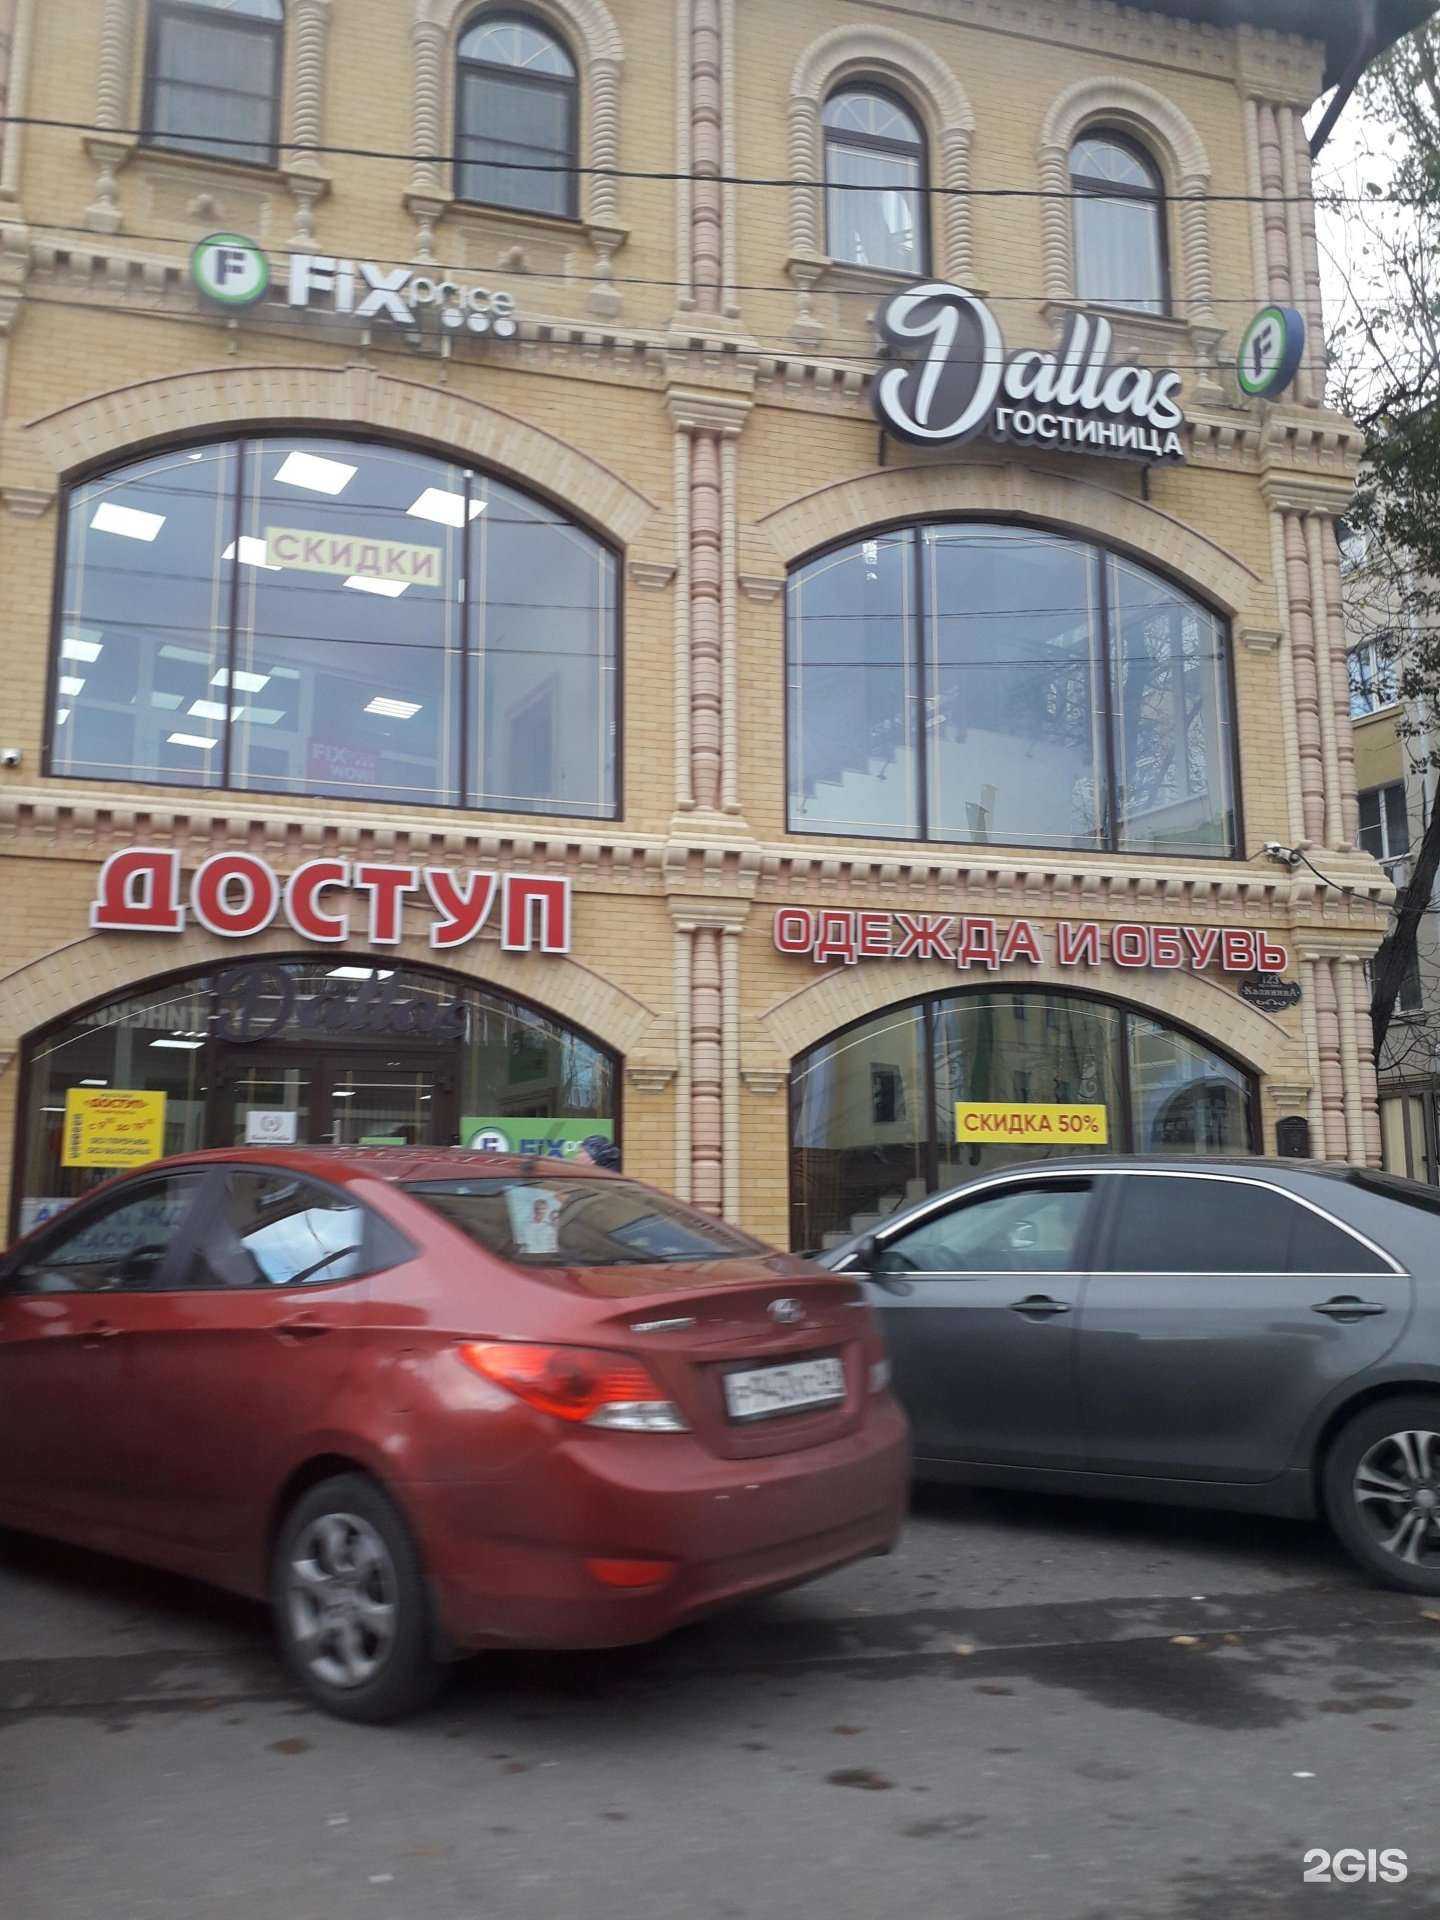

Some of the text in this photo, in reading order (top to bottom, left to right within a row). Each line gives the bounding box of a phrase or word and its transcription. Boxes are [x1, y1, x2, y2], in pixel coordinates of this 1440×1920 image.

[879, 283, 1182, 439] Dallas
[995, 407, 1184, 456] ГОСТИНИЦА
[273, 534, 433, 578] СКИДКИ
[90, 847, 572, 954] ДОСТУП
[773, 907, 1289, 973] ОДЕЖДА И ОБУВЬ
[964, 1113, 1100, 1135] СКИДКА 50%
